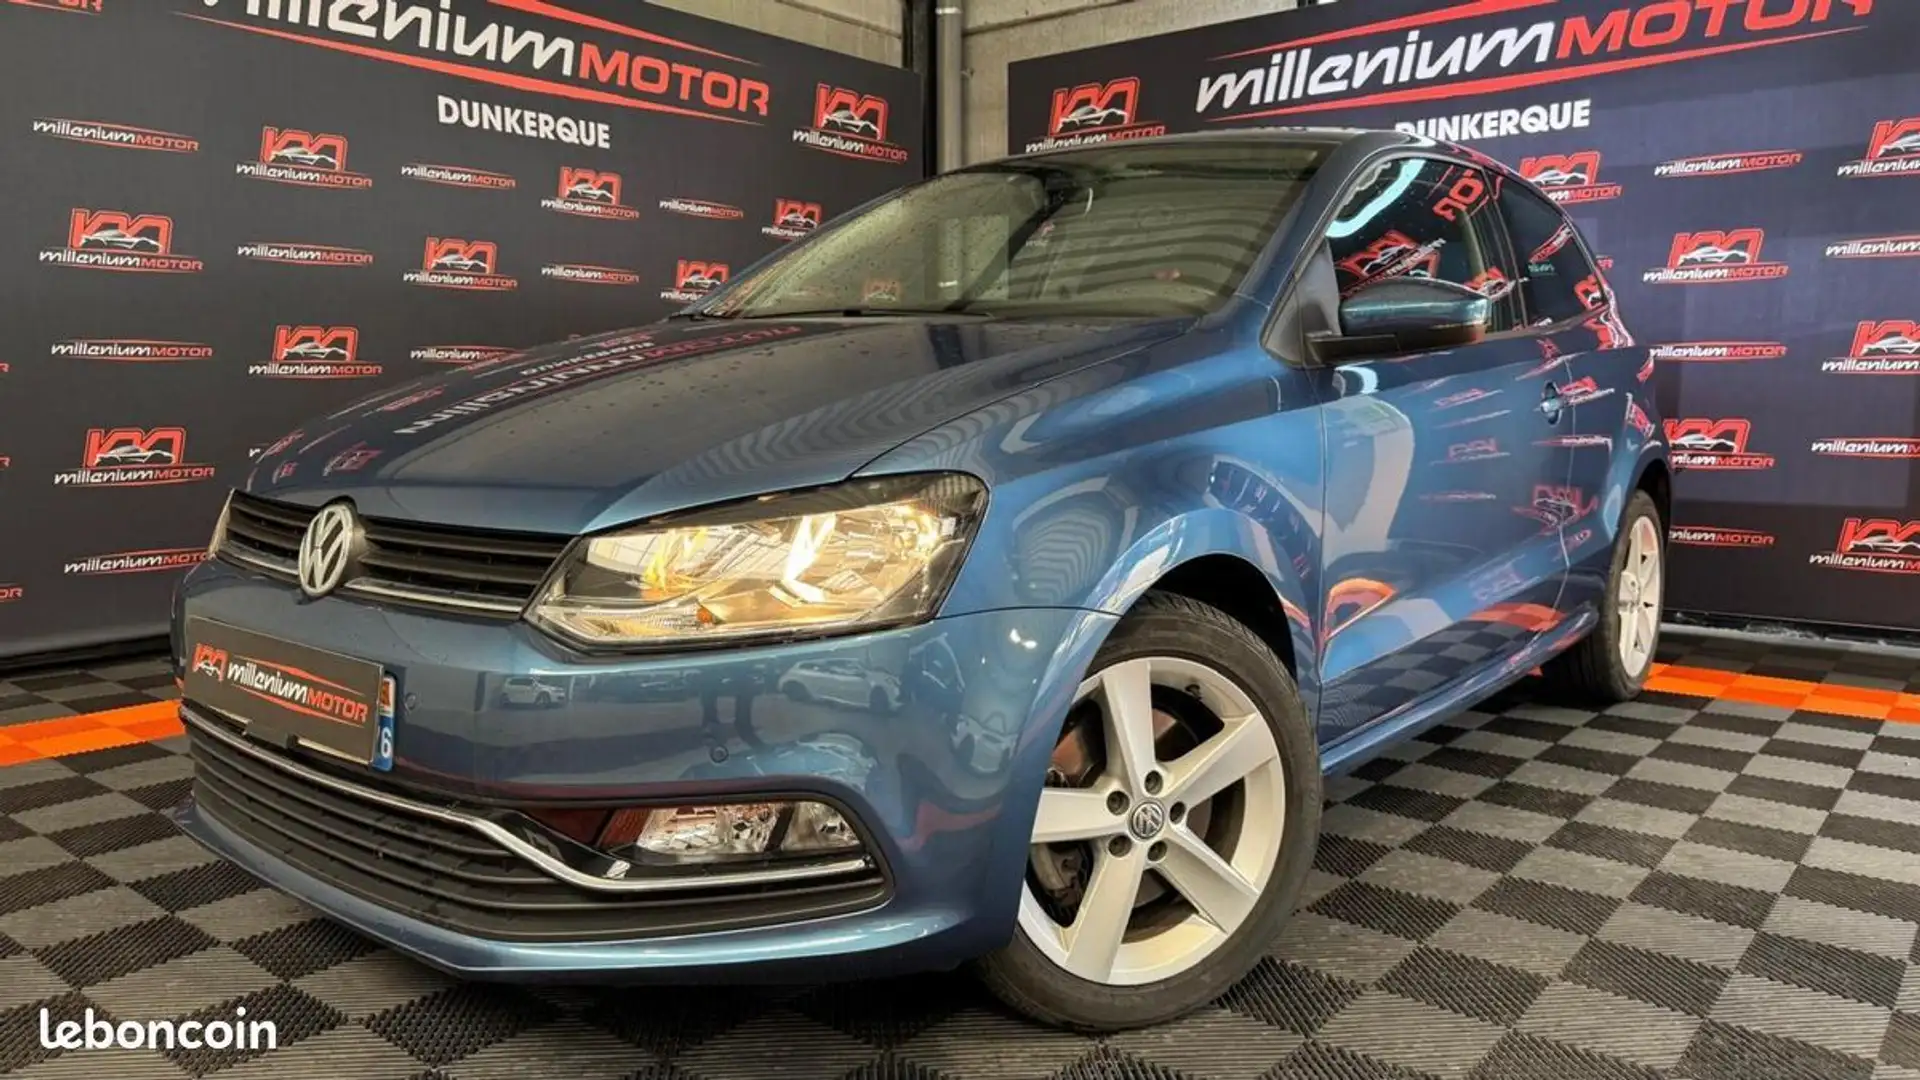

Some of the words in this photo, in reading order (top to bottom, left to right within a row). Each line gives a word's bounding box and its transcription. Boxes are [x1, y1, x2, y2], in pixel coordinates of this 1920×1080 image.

[203, 0, 768, 116] eniumMOTOR
[437, 95, 611, 150] DUNKERQUE
[227, 662, 369, 723] milleniumMOTOR
